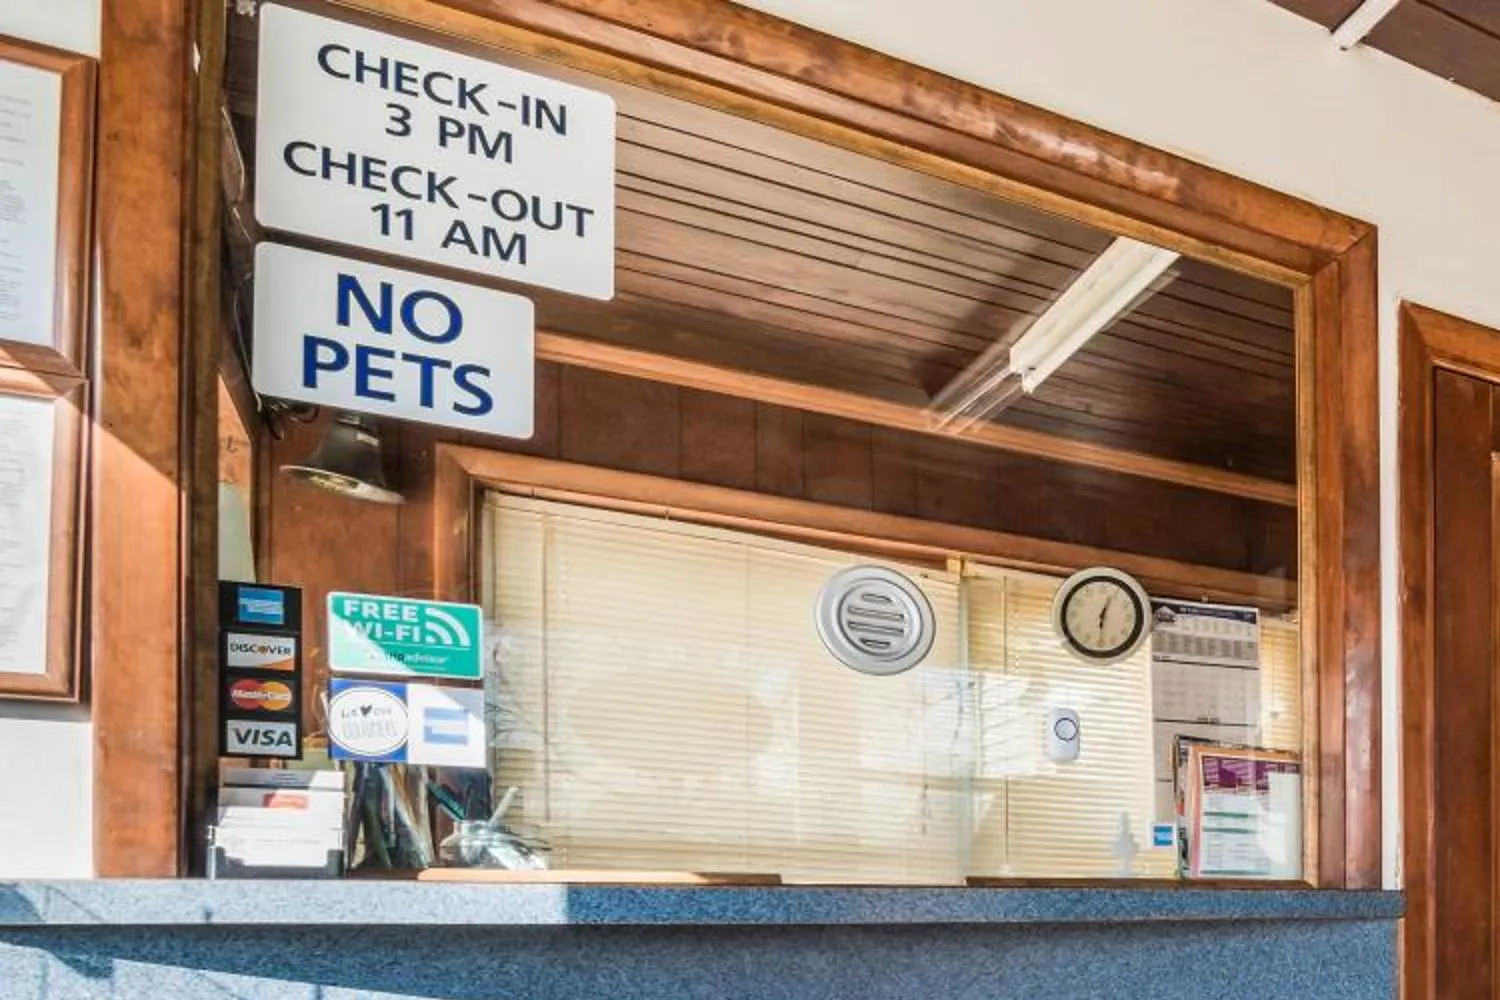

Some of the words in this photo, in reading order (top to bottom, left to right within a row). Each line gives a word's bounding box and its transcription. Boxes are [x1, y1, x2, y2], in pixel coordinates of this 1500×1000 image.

[317, 43, 568, 137] CHECK-IN
[385, 103, 412, 137] 3
[438, 116, 513, 164] PM
[283, 141, 594, 238] CHECK-OUT
[371, 203, 414, 241] 11
[440, 219, 527, 265] AM
[336, 273, 464, 345] NO
[302, 334, 494, 417] PETS
[344, 599, 420, 622] FREE
[229, 643, 292, 655] DISCOVER
[231, 726, 293, 747] VISA
